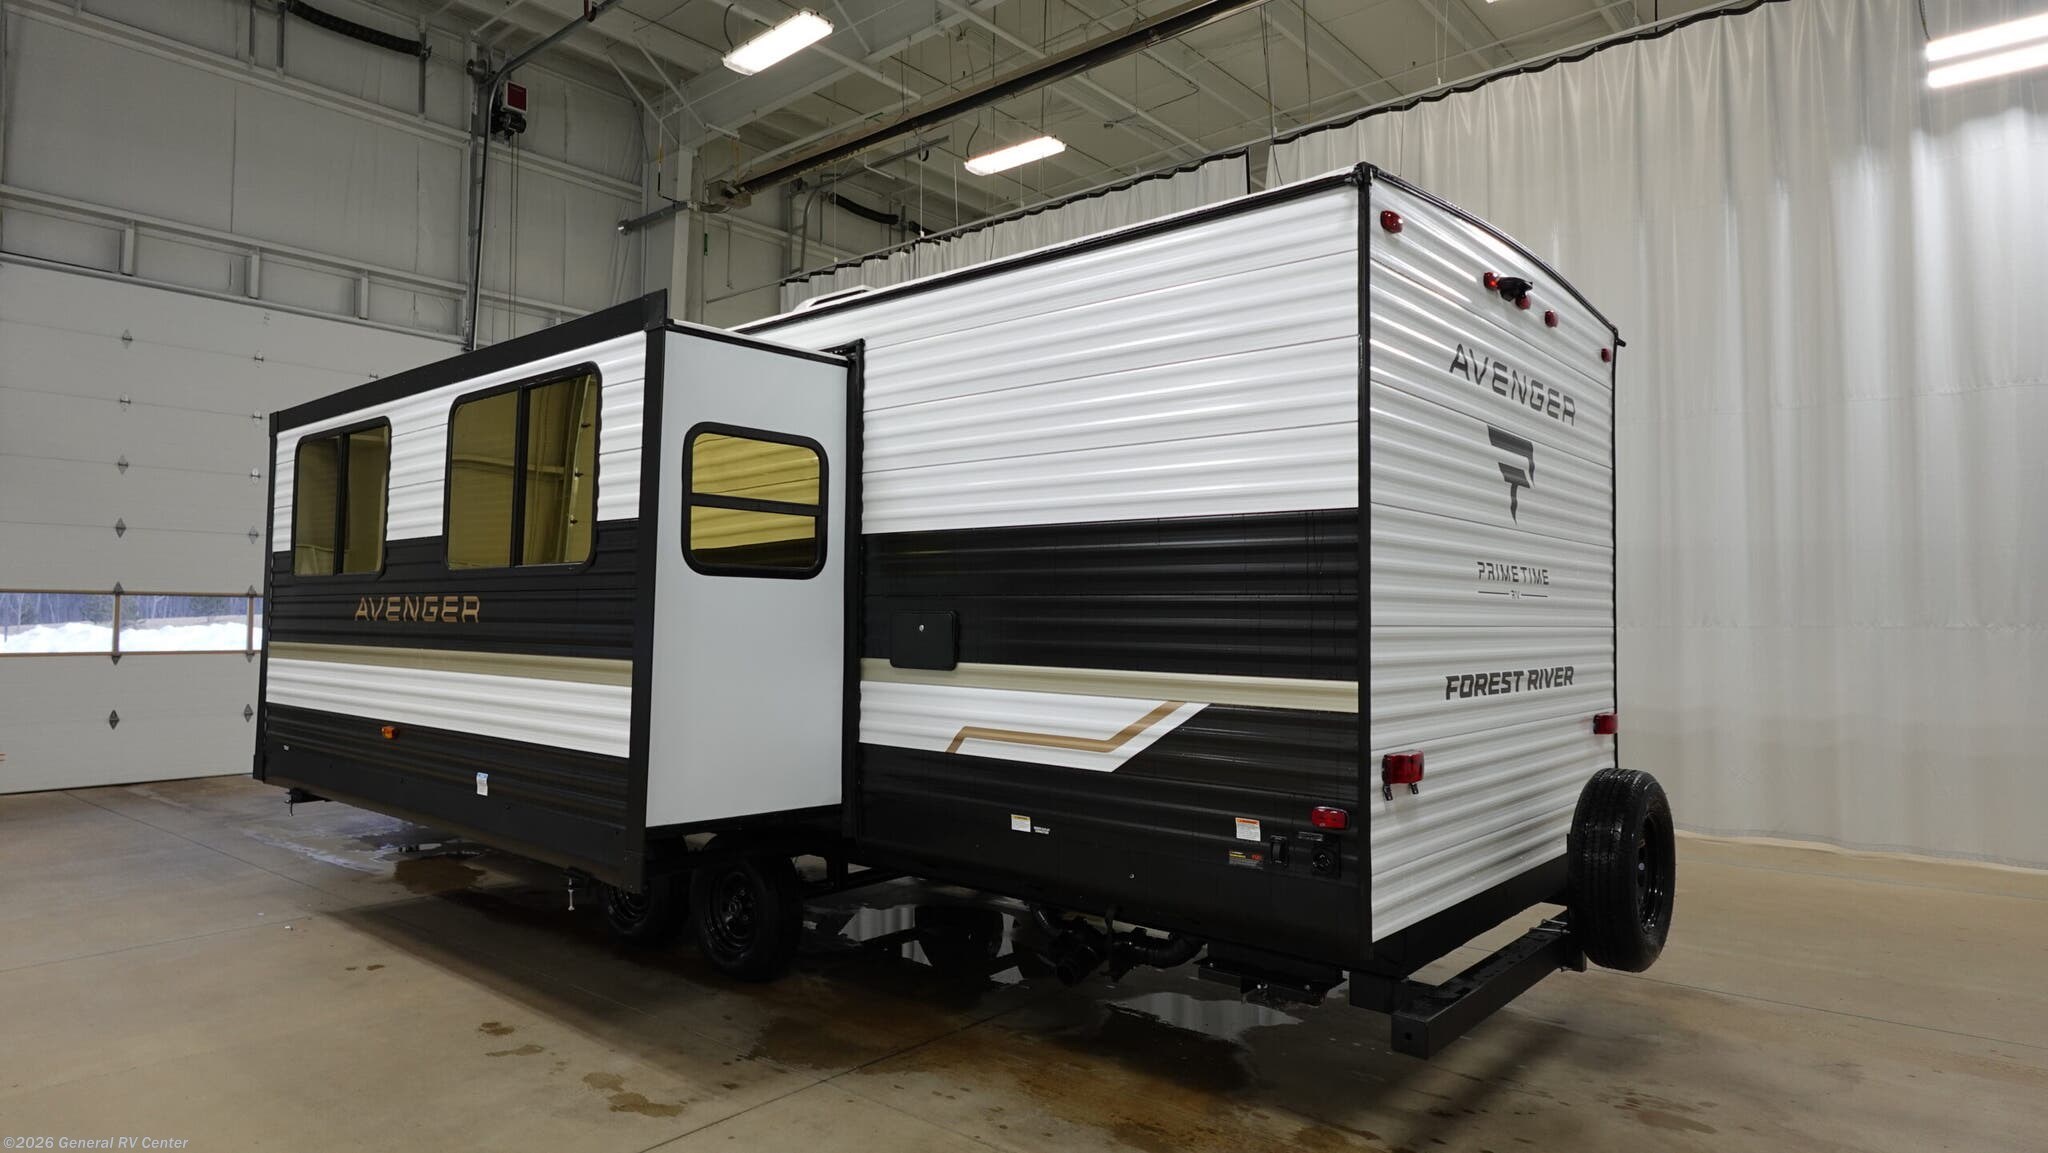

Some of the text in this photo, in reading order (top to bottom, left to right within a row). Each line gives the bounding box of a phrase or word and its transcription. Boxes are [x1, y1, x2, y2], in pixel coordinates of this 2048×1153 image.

[1449, 343, 1577, 427] AVENGER
[354, 595, 481, 623] AVENGER
[1445, 665, 1575, 701] FOREST RIVER
